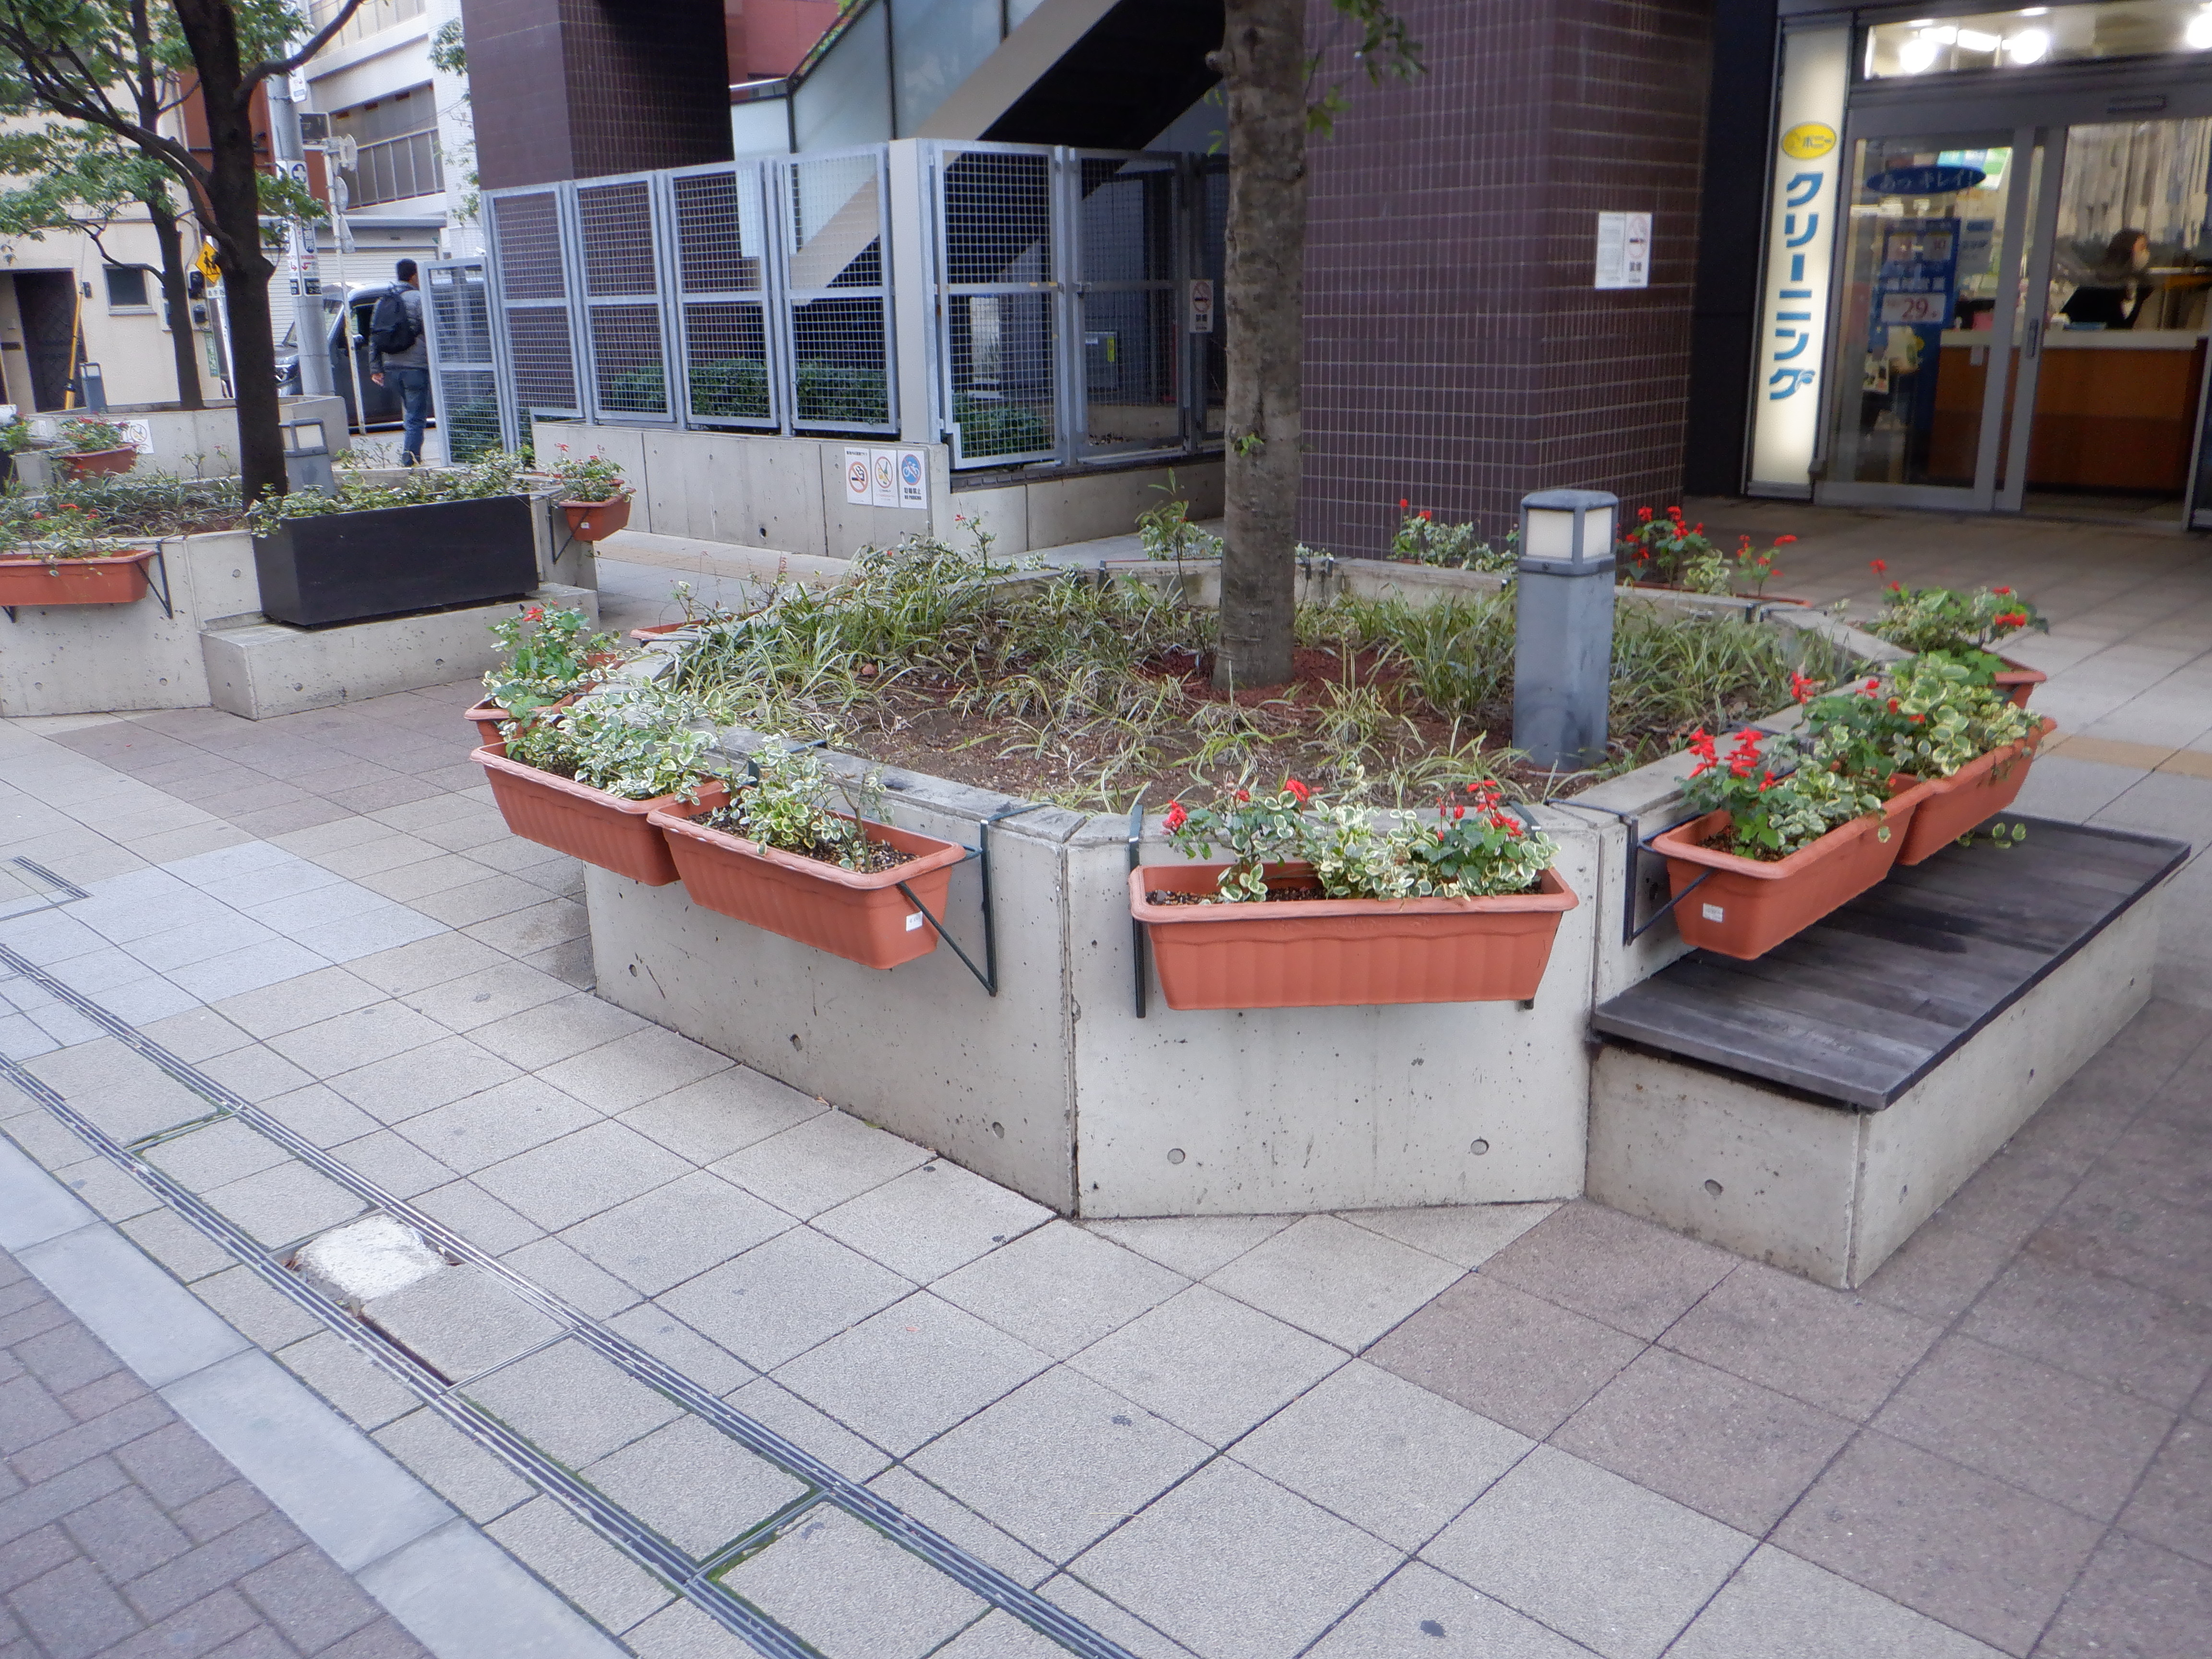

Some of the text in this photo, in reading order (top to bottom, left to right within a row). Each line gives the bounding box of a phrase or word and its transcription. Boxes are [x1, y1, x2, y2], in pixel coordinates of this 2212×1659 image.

[1769, 172, 1824, 400] クリーニング
